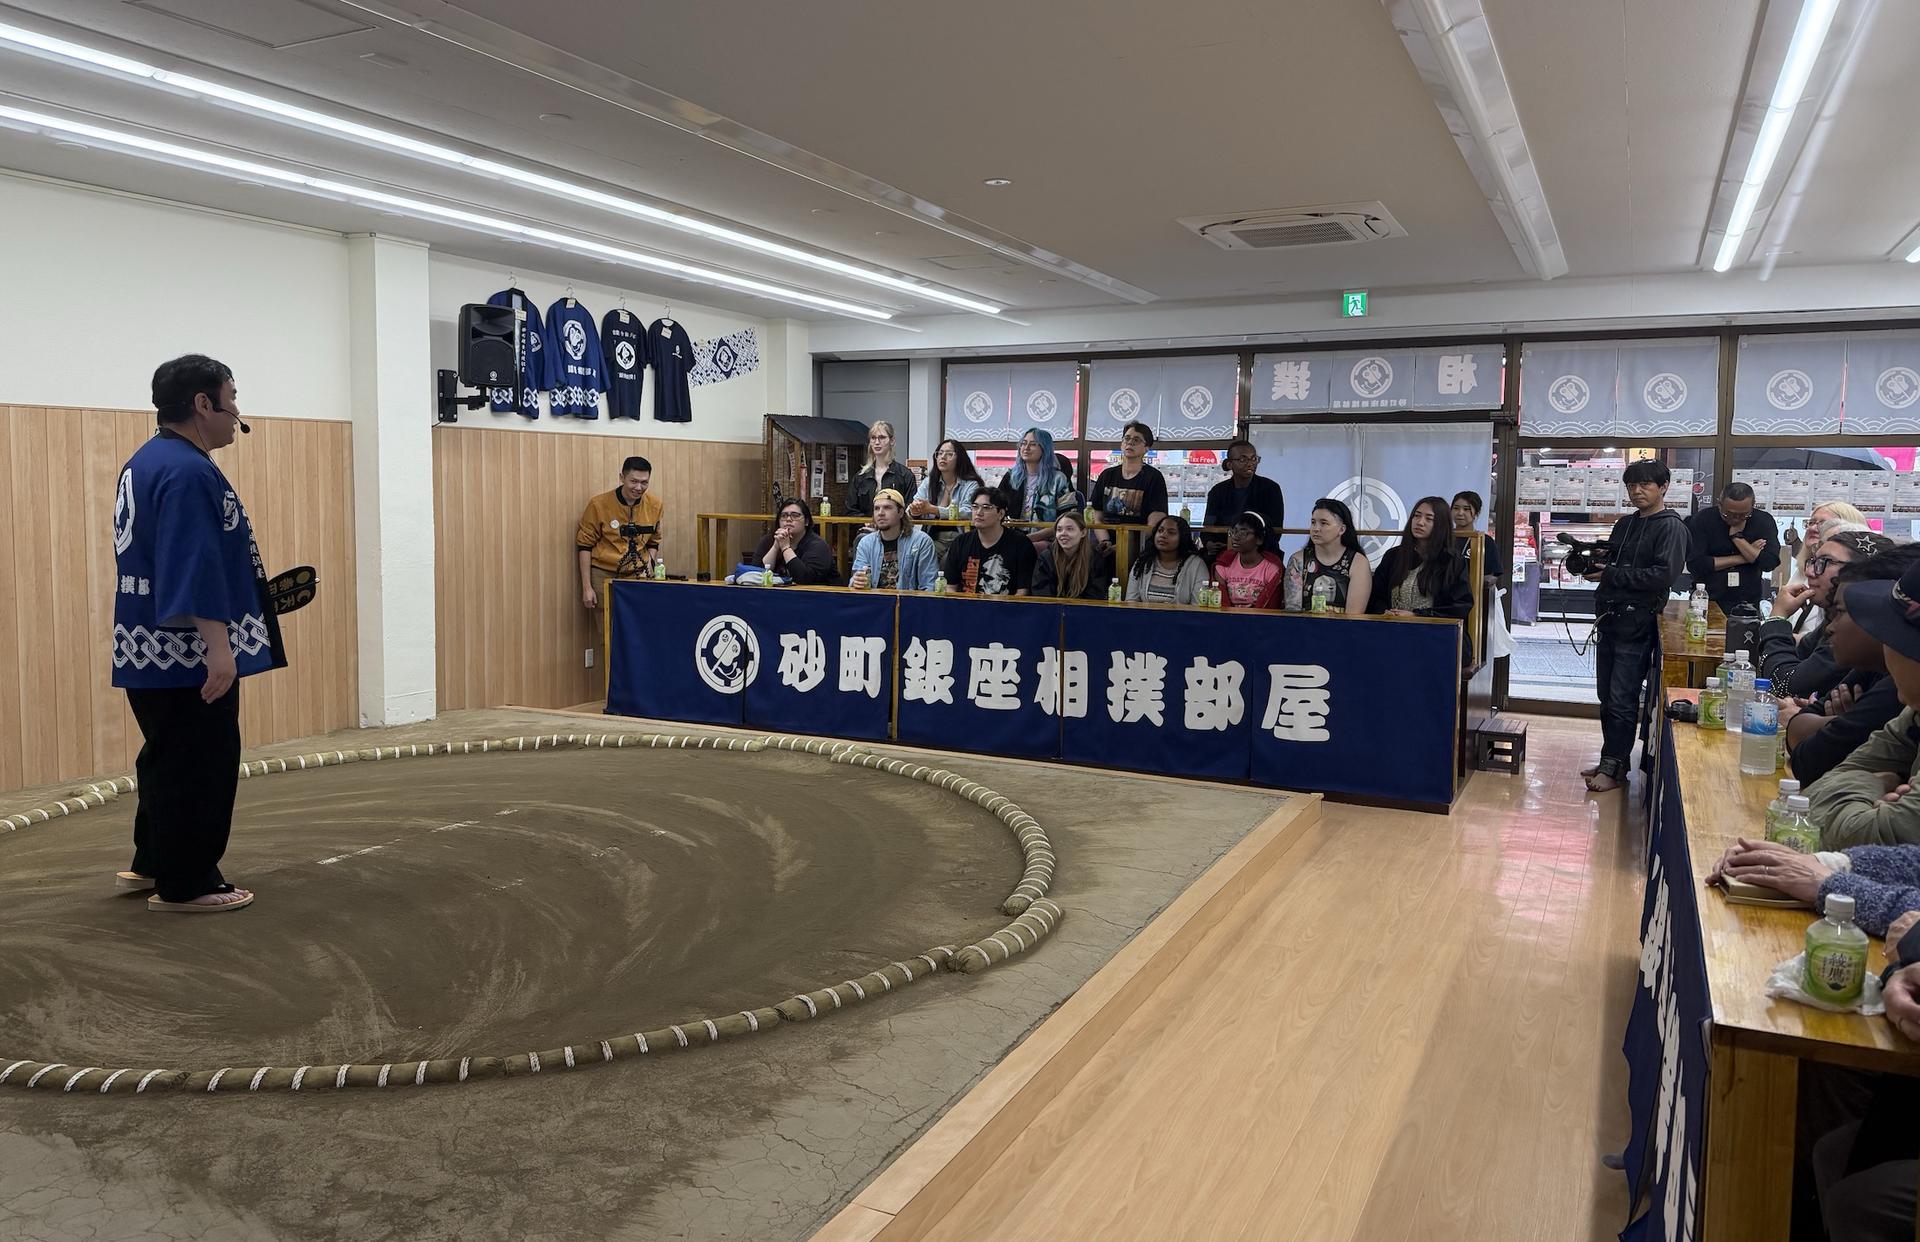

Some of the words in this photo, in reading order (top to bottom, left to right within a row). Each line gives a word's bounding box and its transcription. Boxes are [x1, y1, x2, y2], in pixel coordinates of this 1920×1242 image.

[778, 630, 1330, 741] 砂町銀座相撲部屋
